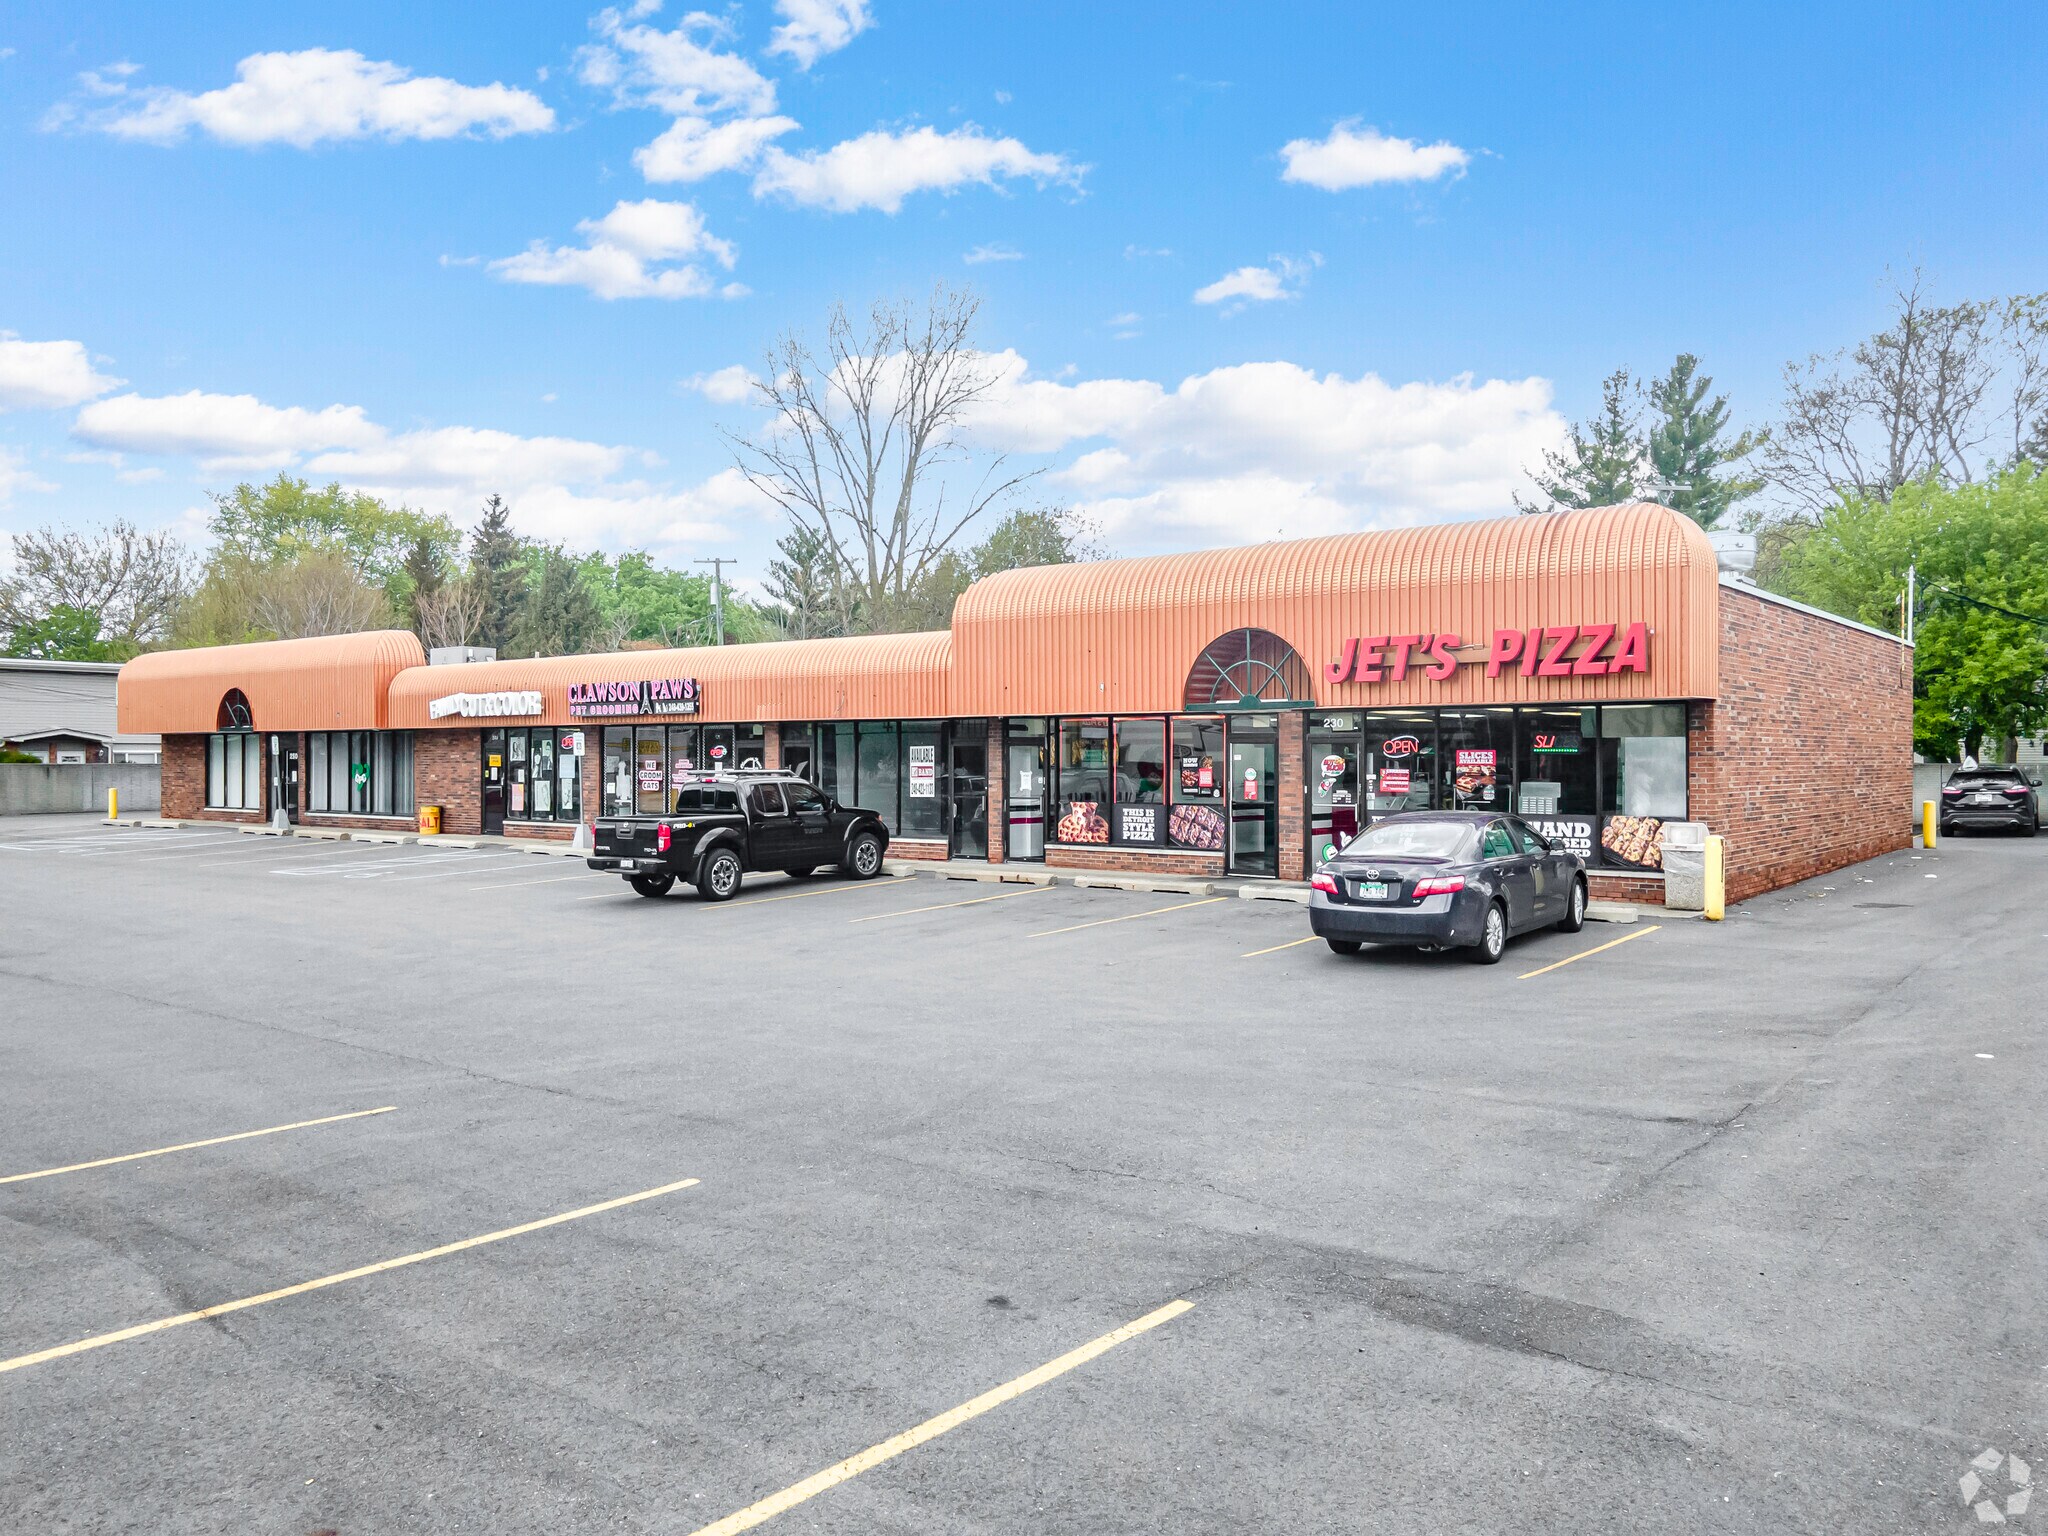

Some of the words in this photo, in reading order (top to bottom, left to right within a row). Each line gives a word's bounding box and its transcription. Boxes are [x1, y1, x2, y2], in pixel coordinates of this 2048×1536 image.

[1325, 633, 1460, 684] JET'S
[1487, 622, 1648, 678] PIZZA
[568, 681, 640, 702] CLAWSON
[650, 679, 694, 700] PAWS
[570, 705, 586, 715] PET
[590, 703, 639, 714] GROOMING
[1323, 718, 1344, 728] 230
[561, 737, 574, 746] OPE
[1383, 740, 1418, 754] OPEN
[1459, 752, 1493, 760] SLICES
[642, 782, 659, 790] CATS
[1123, 808, 1144, 816] THIS
[1145, 808, 1155, 816] IS
[419, 817, 439, 828] ALT
[1123, 823, 1155, 832] STYLE
[1123, 831, 1155, 840] PIZZA
